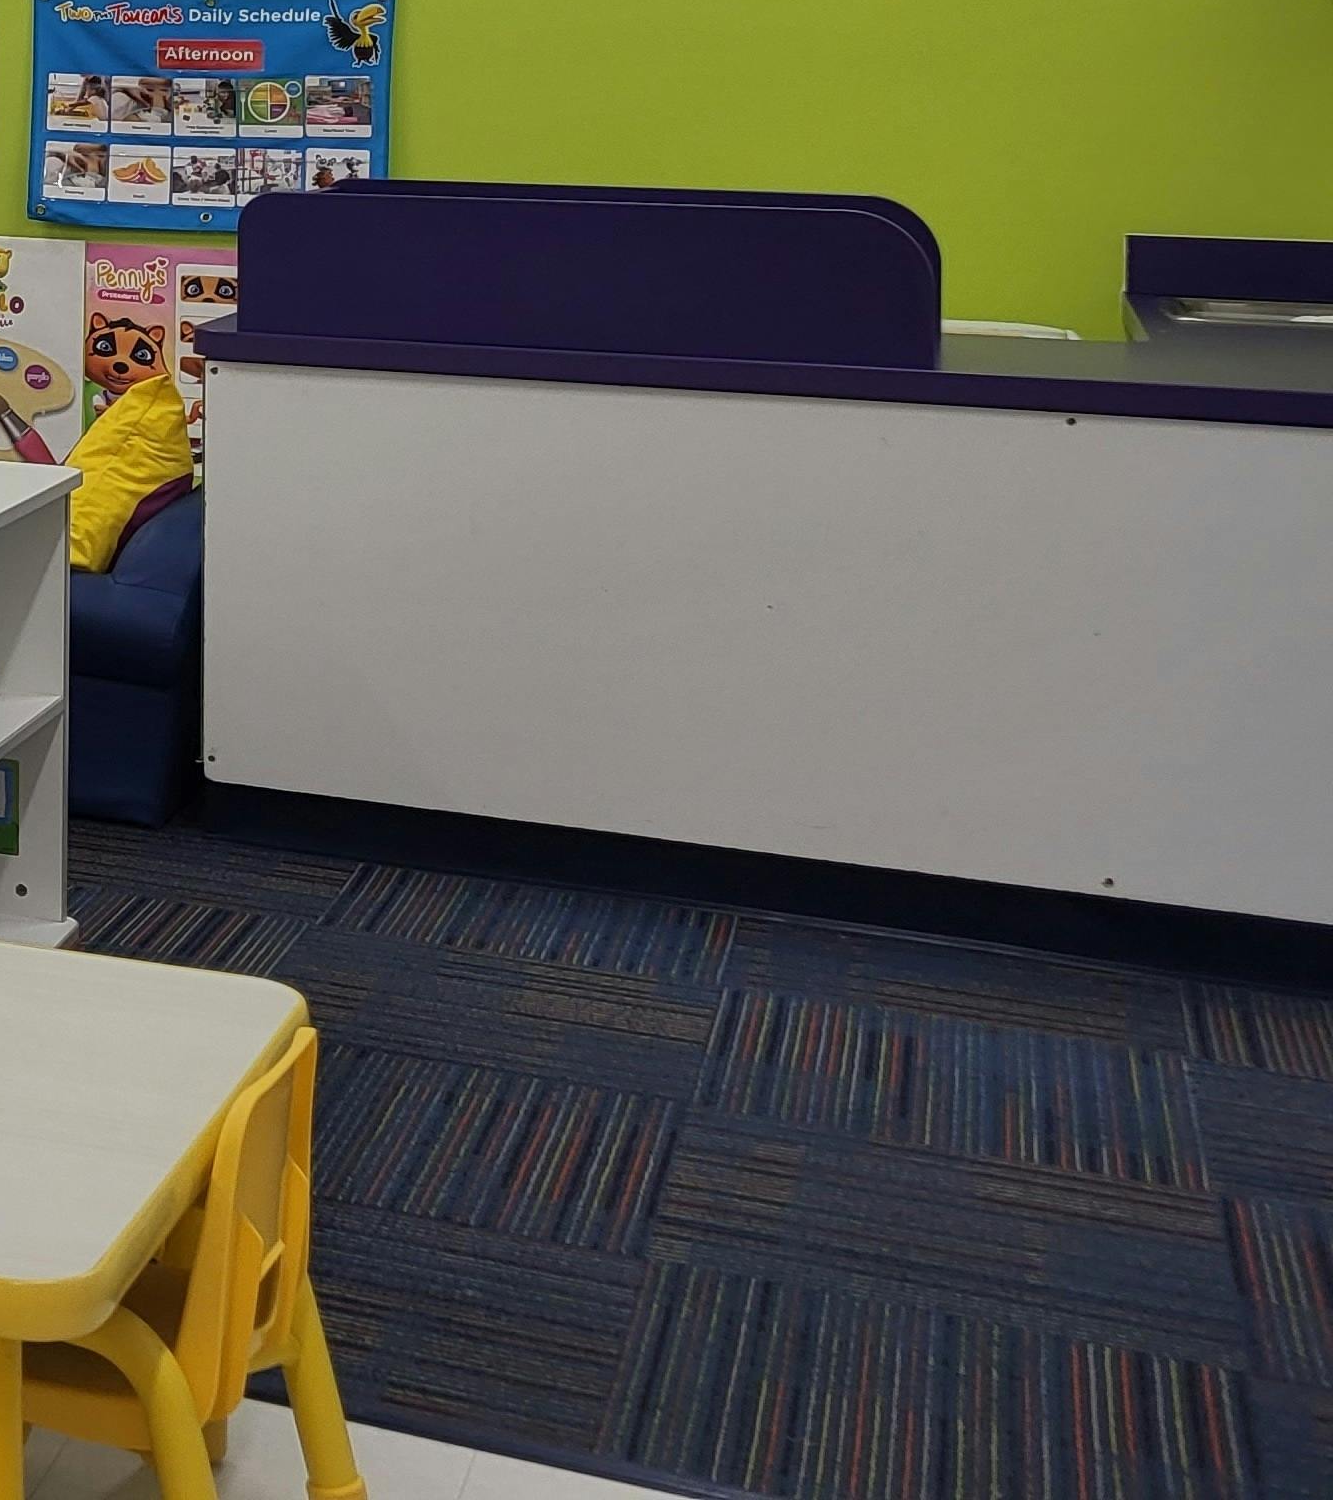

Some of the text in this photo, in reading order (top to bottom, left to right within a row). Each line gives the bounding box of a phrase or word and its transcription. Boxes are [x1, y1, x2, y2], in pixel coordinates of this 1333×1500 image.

[55, 1, 93, 21] Two
[105, 1, 183, 26] Toucan's
[188, 8, 233, 25] Daily
[238, 8, 321, 23] Schedule
[164, 46, 254, 62] Afternoon
[96, 262, 166, 302] Penny's
